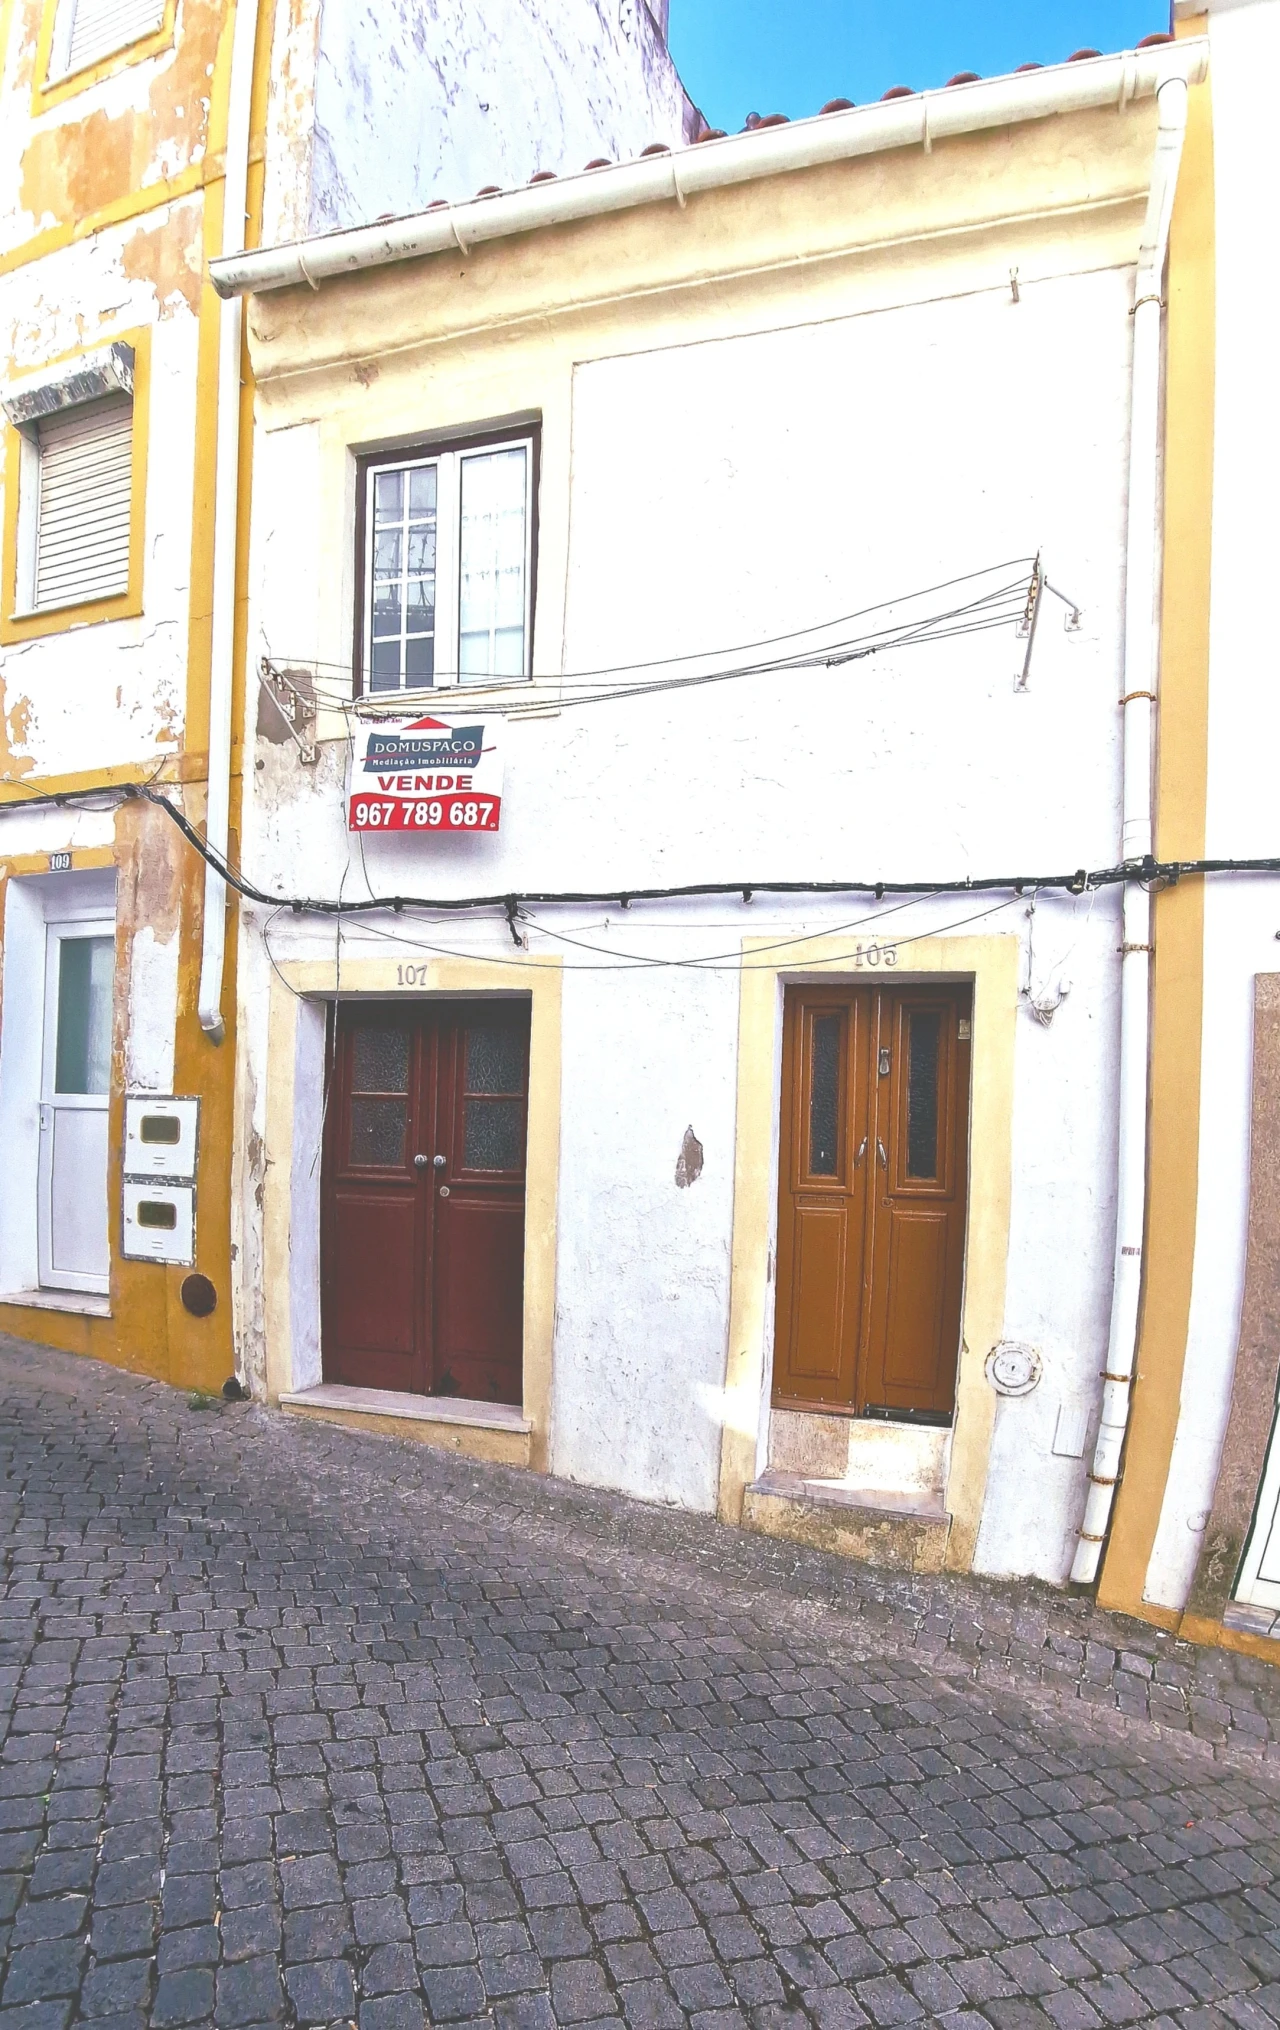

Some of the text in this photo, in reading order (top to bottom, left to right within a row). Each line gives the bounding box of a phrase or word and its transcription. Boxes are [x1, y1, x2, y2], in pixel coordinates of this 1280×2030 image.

[374, 740, 476, 754] DOMUSPAÇO
[372, 756, 473, 766] Mediação Imobiliária
[377, 775, 473, 791] VENDE
[356, 801, 494, 826] 967 789 687
[51, 854, 70, 870] 109
[854, 942, 898, 967] 105
[397, 964, 428, 986] 107
